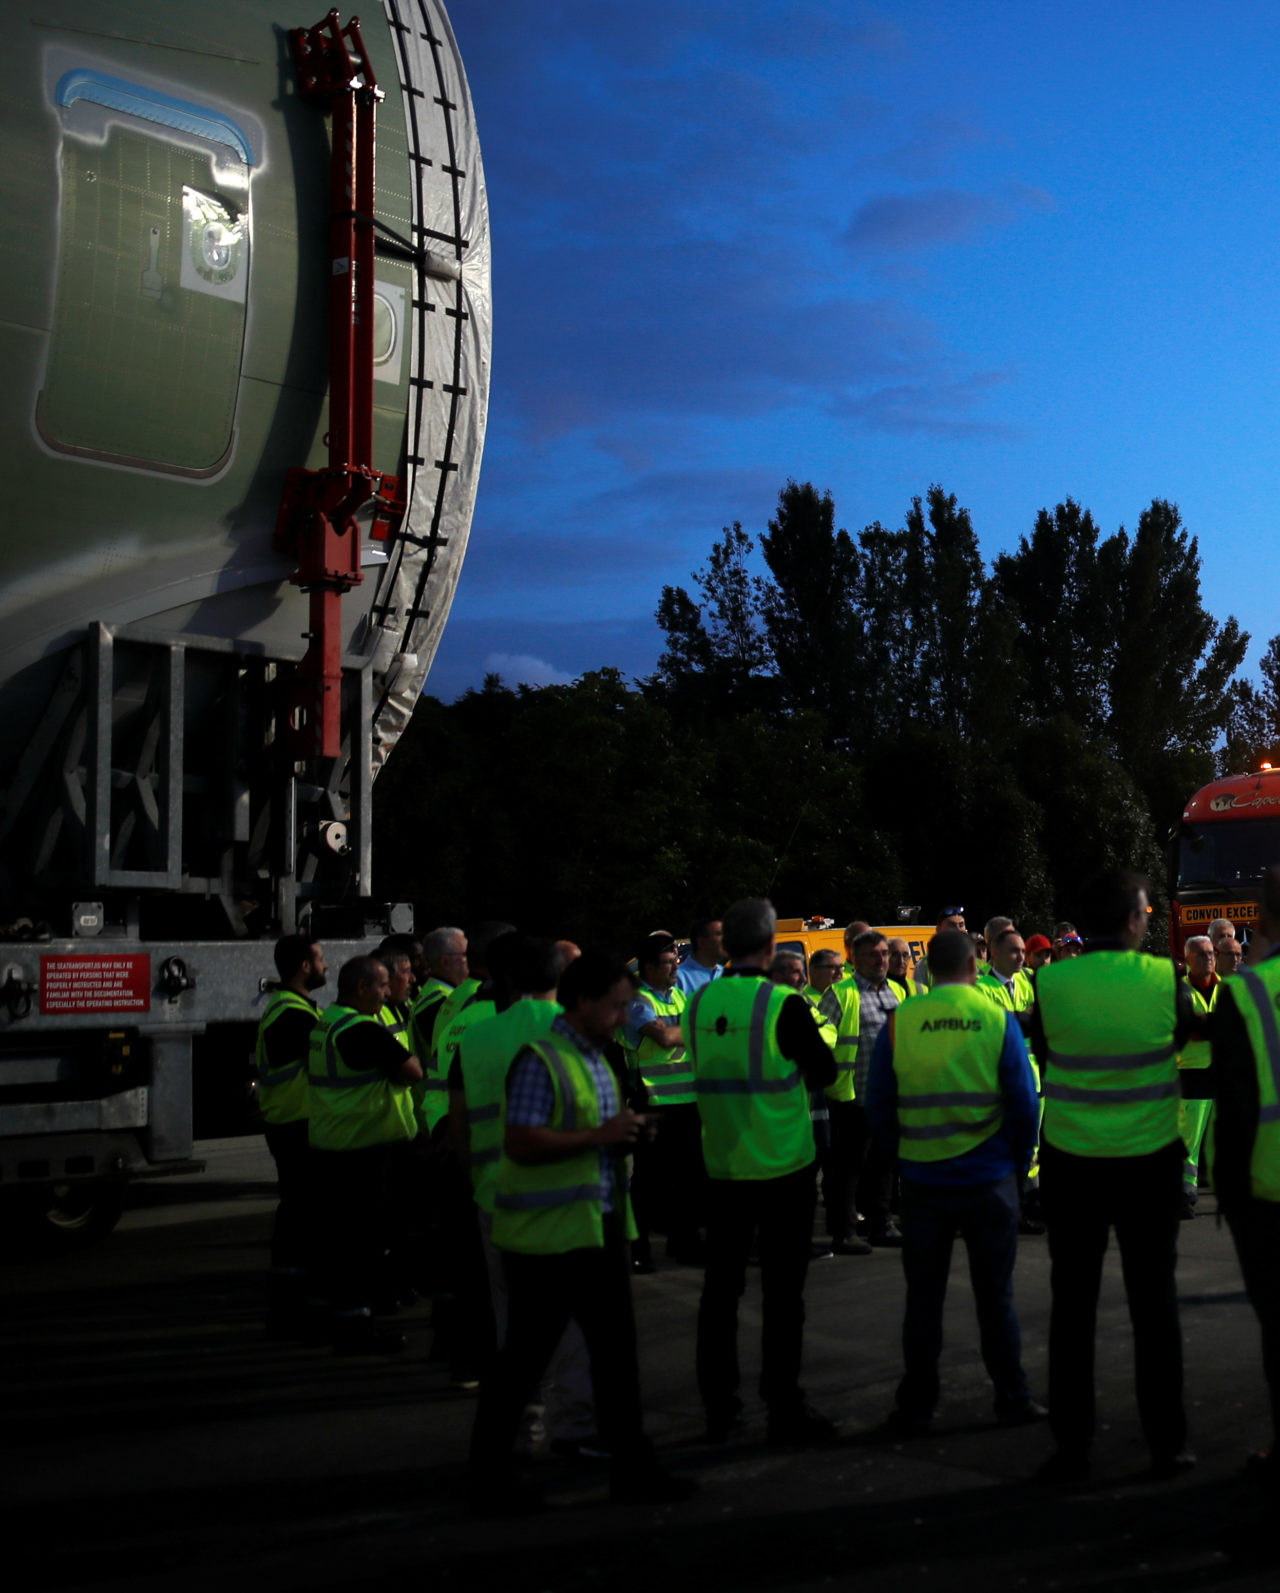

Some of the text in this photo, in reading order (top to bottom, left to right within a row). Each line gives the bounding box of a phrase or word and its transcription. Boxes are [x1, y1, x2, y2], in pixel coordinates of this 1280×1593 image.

[1186, 907, 1223, 921] CONVOI
[46, 962, 56, 970] THE
[46, 972, 72, 980] OPERATED
[80, 971, 102, 979] PERSONS
[72, 981, 102, 989] INSTRUCTED
[46, 991, 70, 999] FAMILIAR
[84, 990, 93, 998] THE
[46, 1001, 75, 1009] ESPECIALLY
[76, 1000, 85, 1008] THE
[86, 1000, 112, 1008] OPERATING
[920, 1018, 982, 1033] AIRBUS
